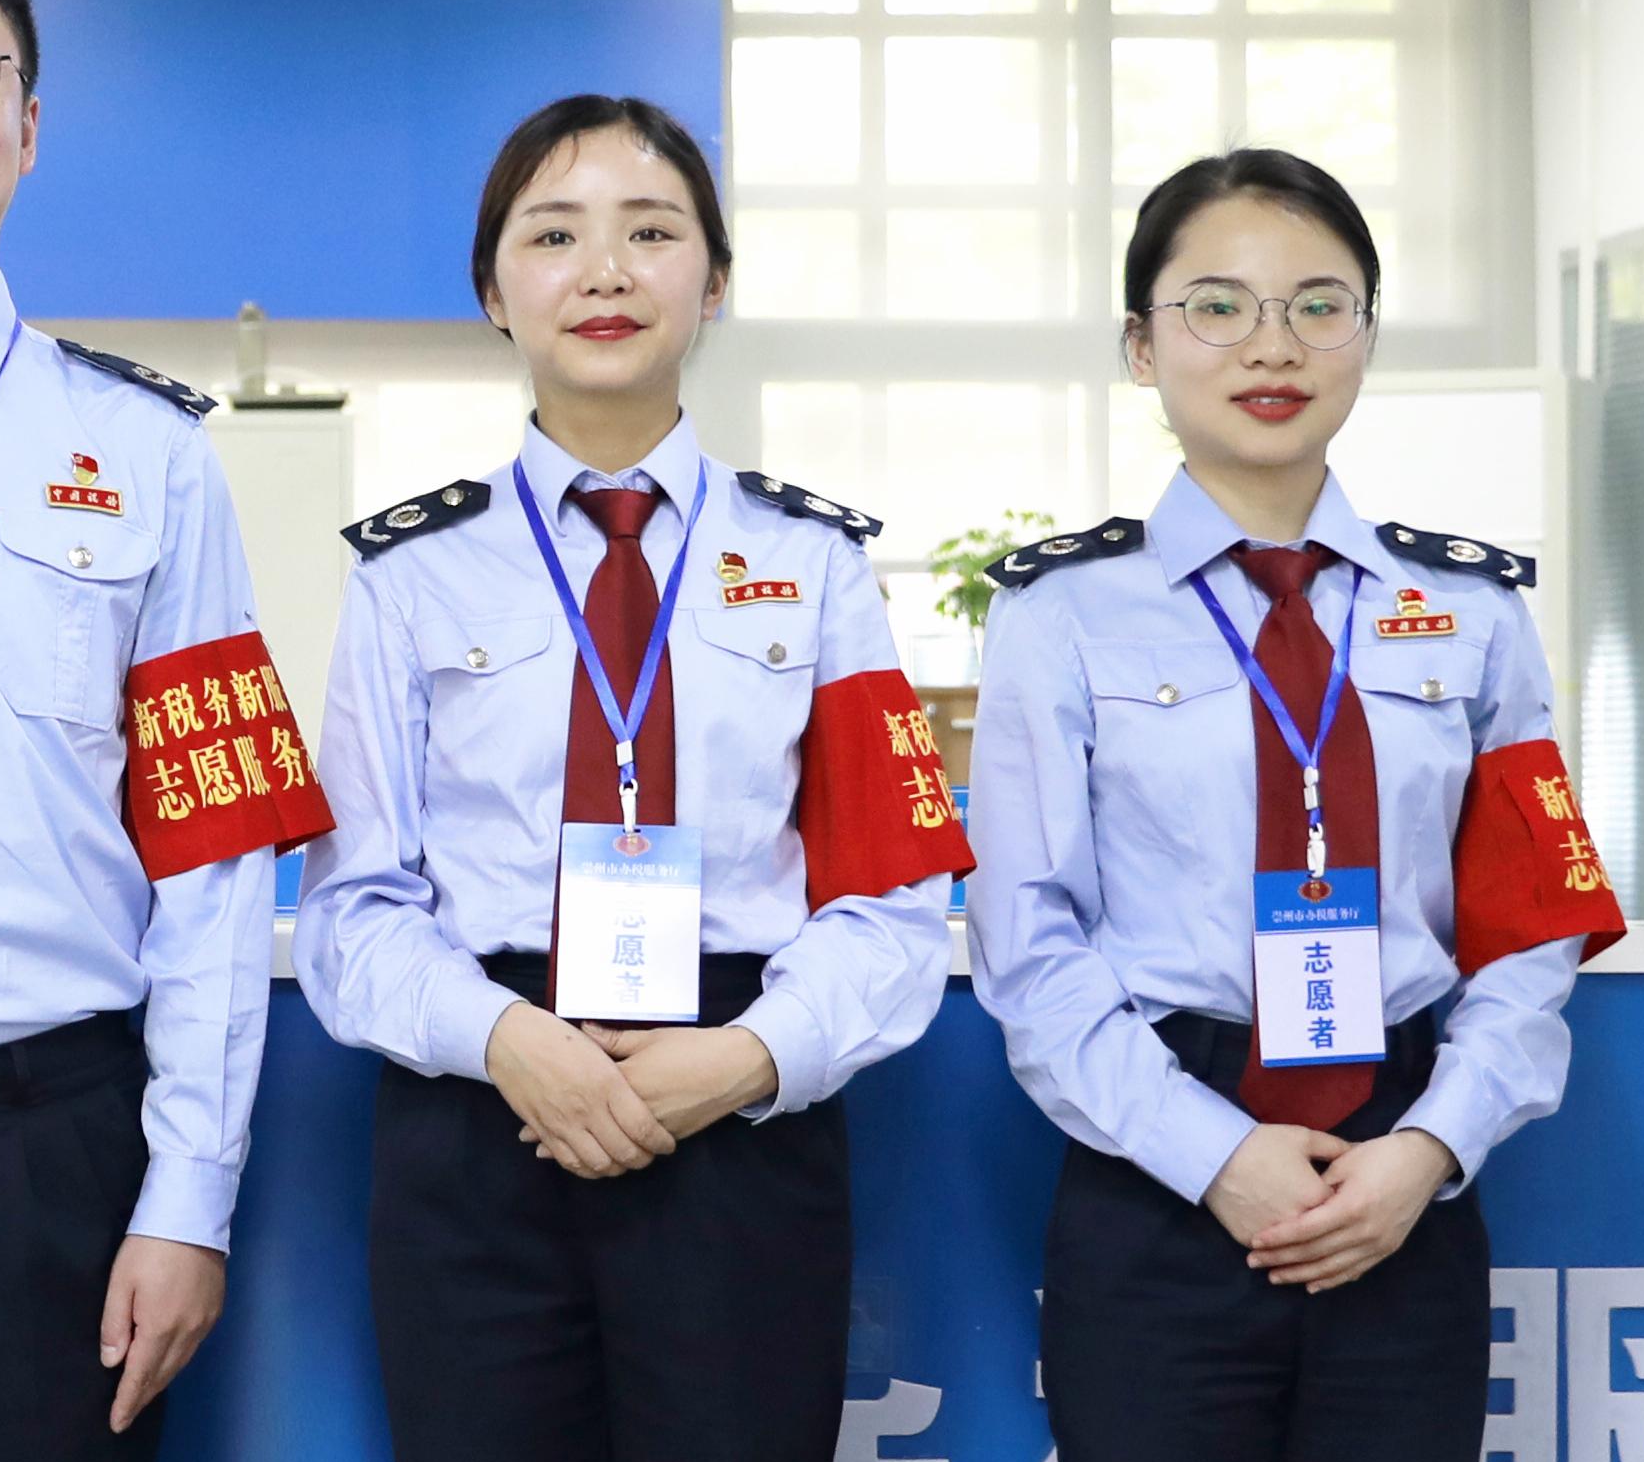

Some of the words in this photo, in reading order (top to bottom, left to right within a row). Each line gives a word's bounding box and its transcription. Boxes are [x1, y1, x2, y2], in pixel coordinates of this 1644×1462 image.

[147, 726, 319, 821] 志愿服务
[1533, 776, 1582, 820] 新
[1559, 830, 1613, 891] 志
[1304, 941, 1337, 1049] 志愿者
